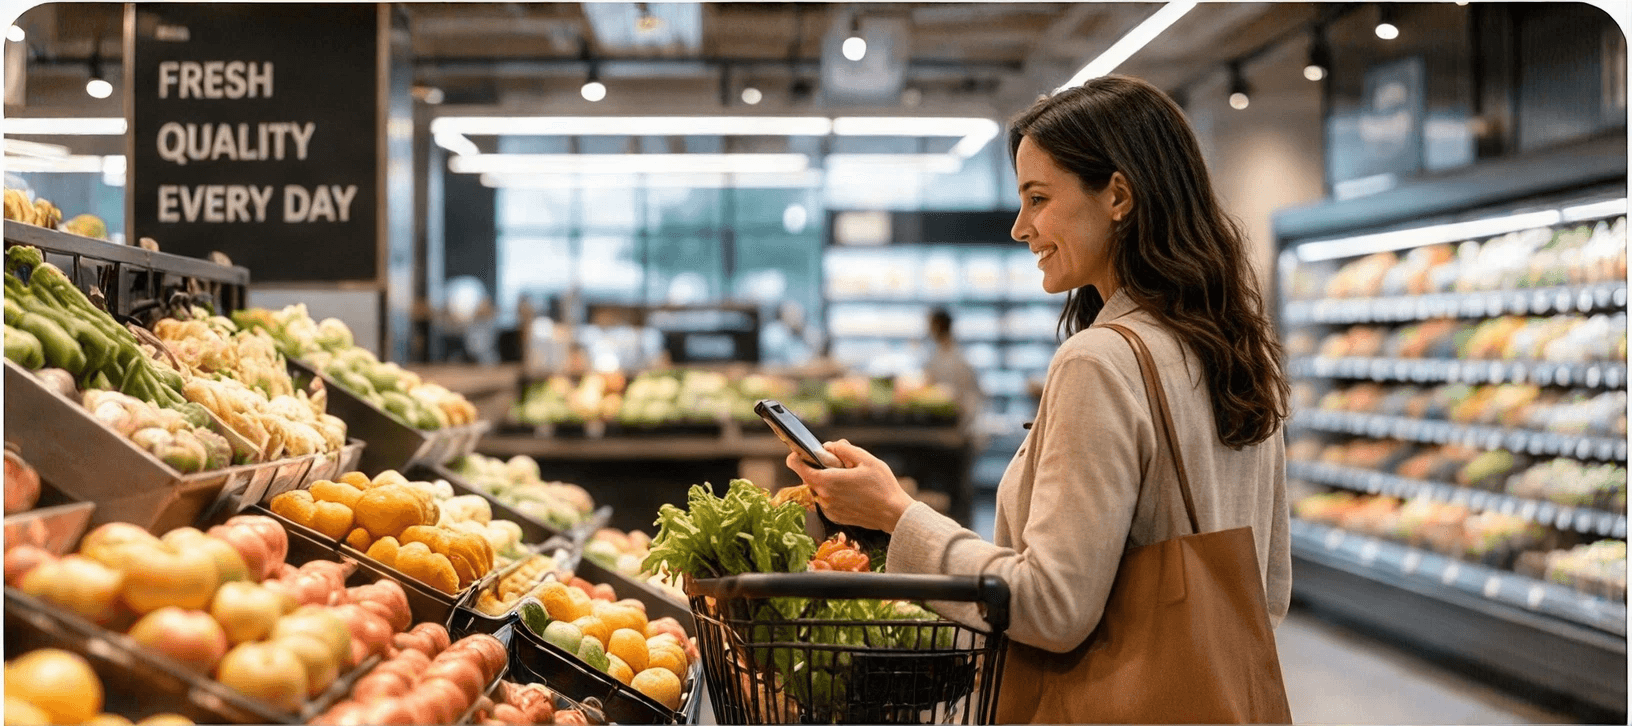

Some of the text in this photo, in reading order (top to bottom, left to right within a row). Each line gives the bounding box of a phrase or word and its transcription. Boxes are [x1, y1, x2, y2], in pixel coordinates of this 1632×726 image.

[159, 61, 273, 98] FRESH
[157, 122, 315, 164] QUALITY
[159, 185, 357, 222] EVERY DAY
